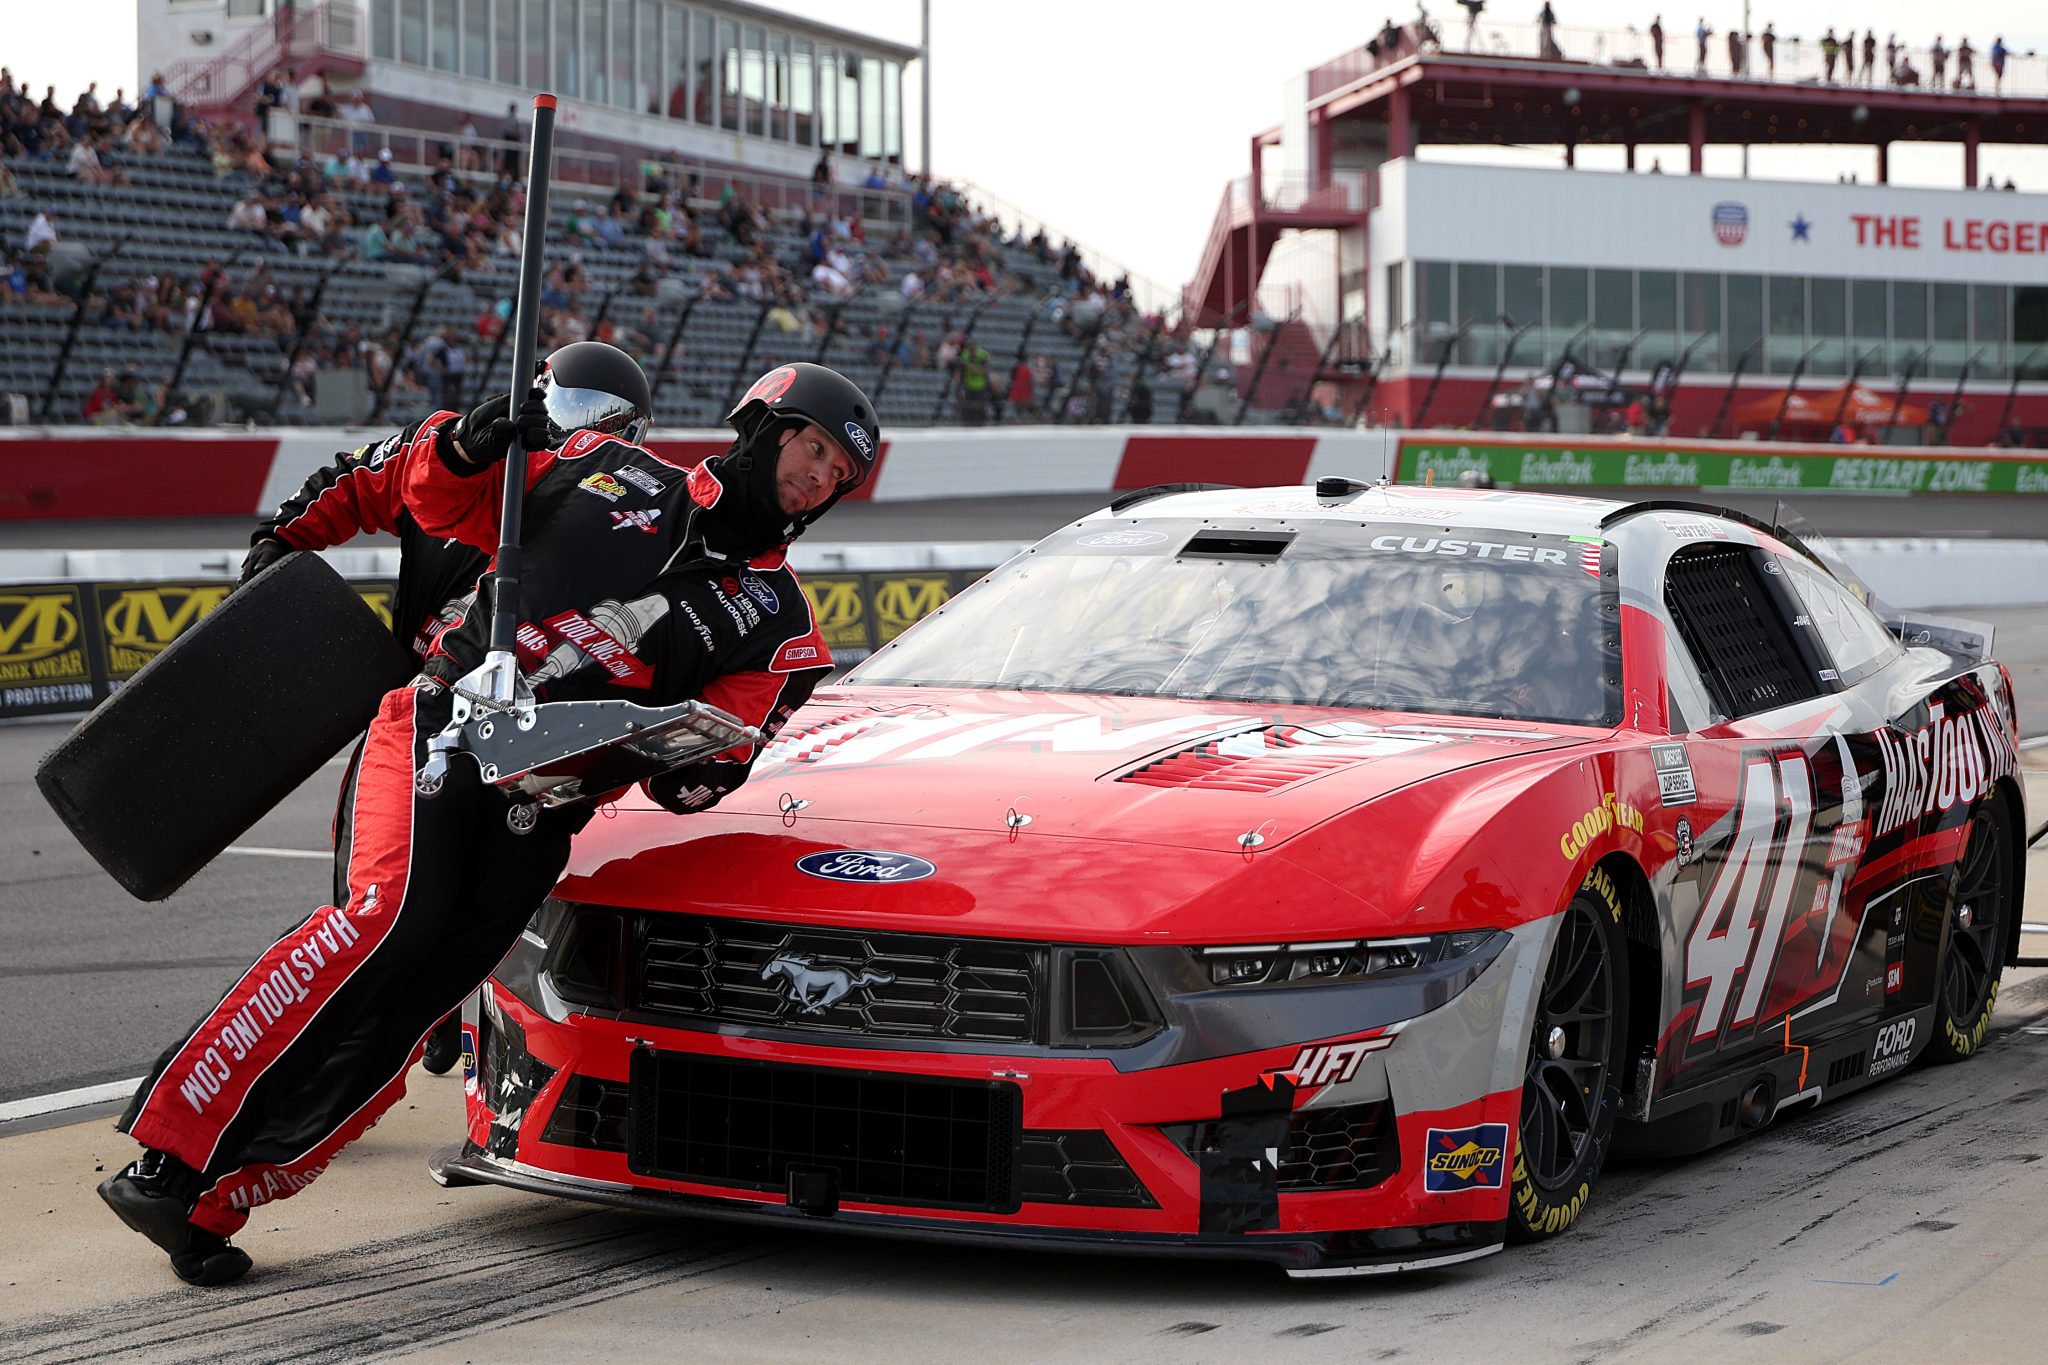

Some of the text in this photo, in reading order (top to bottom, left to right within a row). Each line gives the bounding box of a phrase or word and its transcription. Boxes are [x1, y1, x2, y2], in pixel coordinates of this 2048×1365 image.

[1850, 214, 1921, 249] THE
[851, 429, 872, 454] Ford
[1520, 449, 1595, 484] EchoPark
[1623, 451, 1699, 486] EchoPark
[1728, 456, 1802, 488] EchoPark
[1829, 458, 1993, 492] RESTART ZONE
[1369, 535, 1568, 566] CUSTER
[742, 575, 773, 605] Ford
[715, 590, 749, 638] AUTODESK
[735, 592, 761, 627] Haas
[516, 625, 550, 651] HAAS
[786, 647, 817, 660] SIMPSON
[33, 650, 84, 677] WEAR
[4, 682, 94, 706] PROTECTION
[1560, 800, 1645, 860] GOODYEAR
[819, 852, 911, 879] Ford
[1582, 864, 1623, 924] EAGLE
[1686, 756, 1812, 1036] 41
[1872, 1017, 1916, 1060] FORD
[1272, 1036, 1397, 1085] HFT
[1868, 1050, 1911, 1078] PERFORMANCE
[1431, 1148, 1499, 1171] SUNOCO
